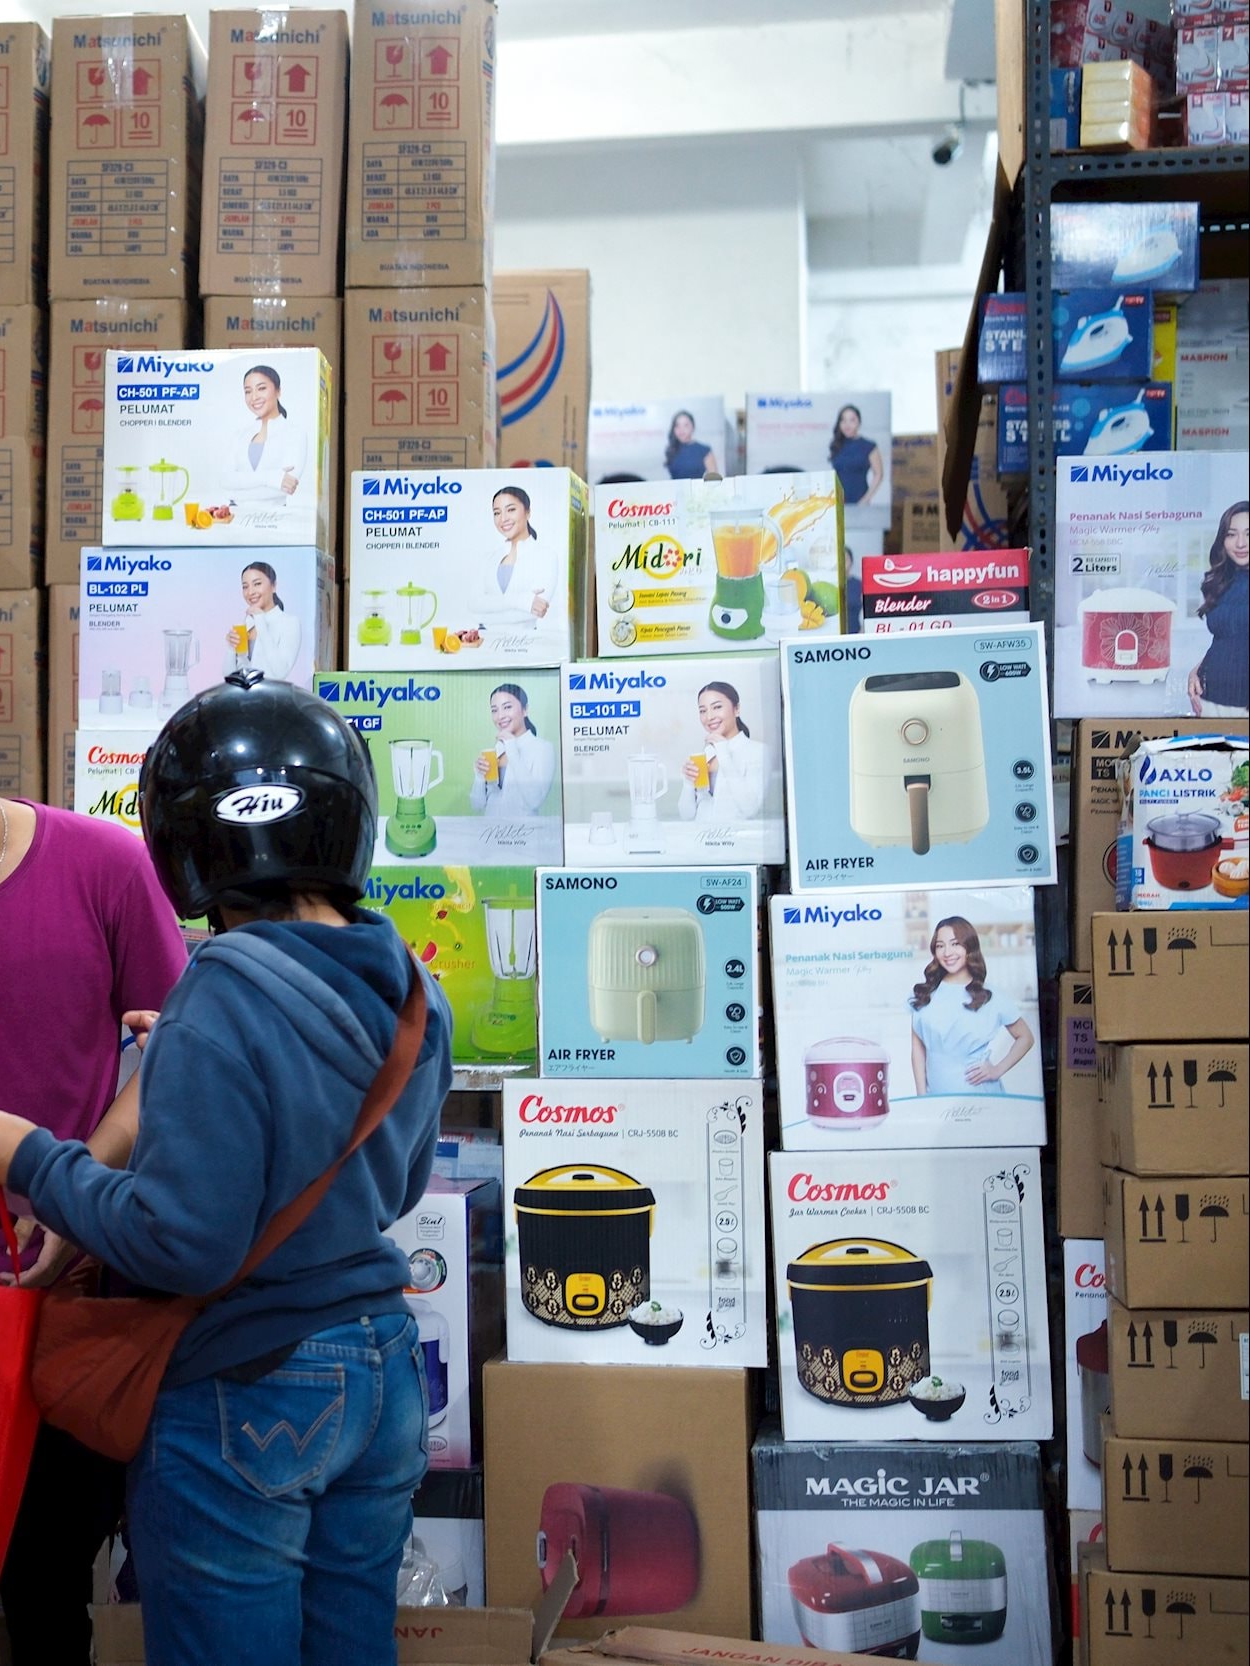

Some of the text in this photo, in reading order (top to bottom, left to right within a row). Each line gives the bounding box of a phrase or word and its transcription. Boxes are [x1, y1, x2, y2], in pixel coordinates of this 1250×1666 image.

[372, 10, 461, 27] Matsunichi
[73, 31, 161, 48] Matsunichi
[230, 29, 319, 44] Matsunichi
[431, 92, 448, 109] 10
[131, 112, 149, 129] 10
[287, 109, 306, 127] 10
[366, 229, 379, 238] ADA
[369, 308, 459, 322] Matsunichi
[70, 318, 158, 333] Matsunichi
[226, 315, 316, 332] Matsunichi
[1180, 354, 1228, 362] MASPION
[137, 356, 214, 378] Miyako
[119, 387, 197, 397] CH-501 PF-AP
[428, 388, 448, 406] 10
[120, 404, 174, 414] PELUMAT
[768, 397, 813, 409] Miyako
[1182, 428, 1229, 436] MASPION
[1092, 463, 1173, 486] Miyako
[383, 476, 462, 500] Miyako
[365, 509, 445, 521] CH-501 PF-AP
[608, 500, 671, 518] Cosmos
[1070, 511, 1202, 521] Penanak Nasi Serbaguna
[608, 519, 676, 529] Pelumat CB-111
[1070, 526, 1136, 535] Magic Warmer
[366, 527, 422, 537] PELUMAT
[612, 543, 701, 571] Midori
[105, 555, 171, 575] Miyako
[1072, 557, 1083, 572] 2
[1085, 564, 1117, 572] Liters
[927, 563, 1019, 584] happyfun
[89, 584, 146, 594] BL-102 PL
[875, 596, 931, 613] Blender
[983, 594, 1008, 604] 2 in 1
[89, 604, 137, 612] PELUMAT
[979, 640, 1026, 650] SW-AFW35
[794, 647, 871, 664] SAMONO
[589, 671, 666, 694] Miyako
[344, 679, 440, 708] Miyako
[572, 703, 638, 716] BL-101 PL
[363, 718, 379, 728] GF
[574, 725, 629, 736] PELUMAT
[88, 746, 146, 764] Cosmos
[1159, 768, 1213, 782] AXLO
[1173, 789, 1216, 797] LISTRIK
[89, 790, 138, 816] Mid
[806, 856, 875, 871] AIR FRYER
[545, 877, 617, 890] SAMONO
[805, 904, 882, 928] Miyako
[785, 950, 913, 963] Penanak Nasi Serbaguna
[431, 959, 475, 969] Crusher
[726, 965, 744, 973] 2.4L
[786, 966, 850, 977] Magic Warmer
[1073, 1034, 1088, 1042] TS
[548, 1049, 616, 1060] AIR FRYER
[519, 1094, 618, 1124] Cosmos
[519, 1129, 678, 1138] Penanak Nasi Serbaguna CRJ-5508 BC
[787, 1173, 890, 1202] Cosmos
[789, 1206, 929, 1218] Jar Warmer Cooker CRJ-5508 BC
[841, 1498, 955, 1507] THE MAGIC IN LIFE
[394, 1627, 443, 1638] JAN
[683, 1648, 780, 1663] JANGAN
